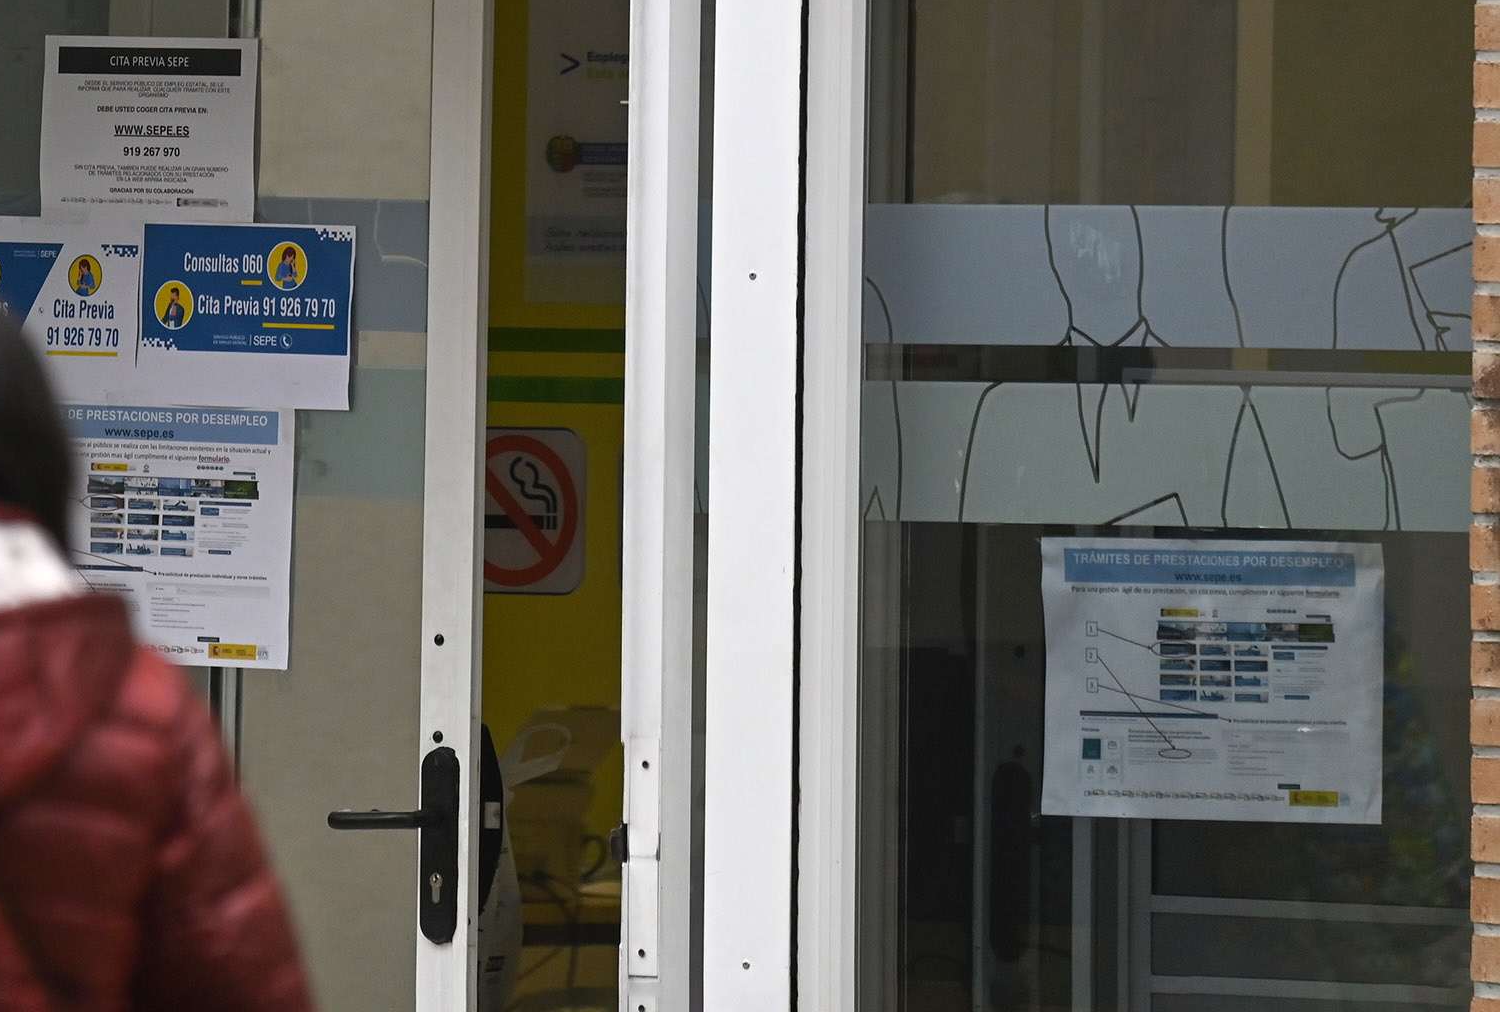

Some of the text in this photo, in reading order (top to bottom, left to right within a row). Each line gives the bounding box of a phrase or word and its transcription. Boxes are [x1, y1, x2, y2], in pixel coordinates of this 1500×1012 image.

[109, 55, 189, 68] CITA PREVIA SEPE
[114, 125, 190, 137] WWW.SEPE.ES
[123, 146, 181, 157] 919 267 970
[40, 250, 57, 258] SEPE
[184, 252, 263, 274] Consultas 060
[53, 298, 115, 319] Cita Previa
[198, 294, 336, 318] Cita Previa 91 926 79 70
[47, 327, 119, 347] 91 926 79 70
[253, 335, 277, 347] SEPE
[68, 408, 268, 427] DE PRESTACIONES POR DESEMPLEO
[104, 427, 175, 440] www.sepe.es
[1075, 551, 1131, 565] TRÁMITES
[1134, 554, 1151, 565] DE
[1154, 554, 1240, 566] PRESTACIONES
[1243, 555, 1267, 567] POR
